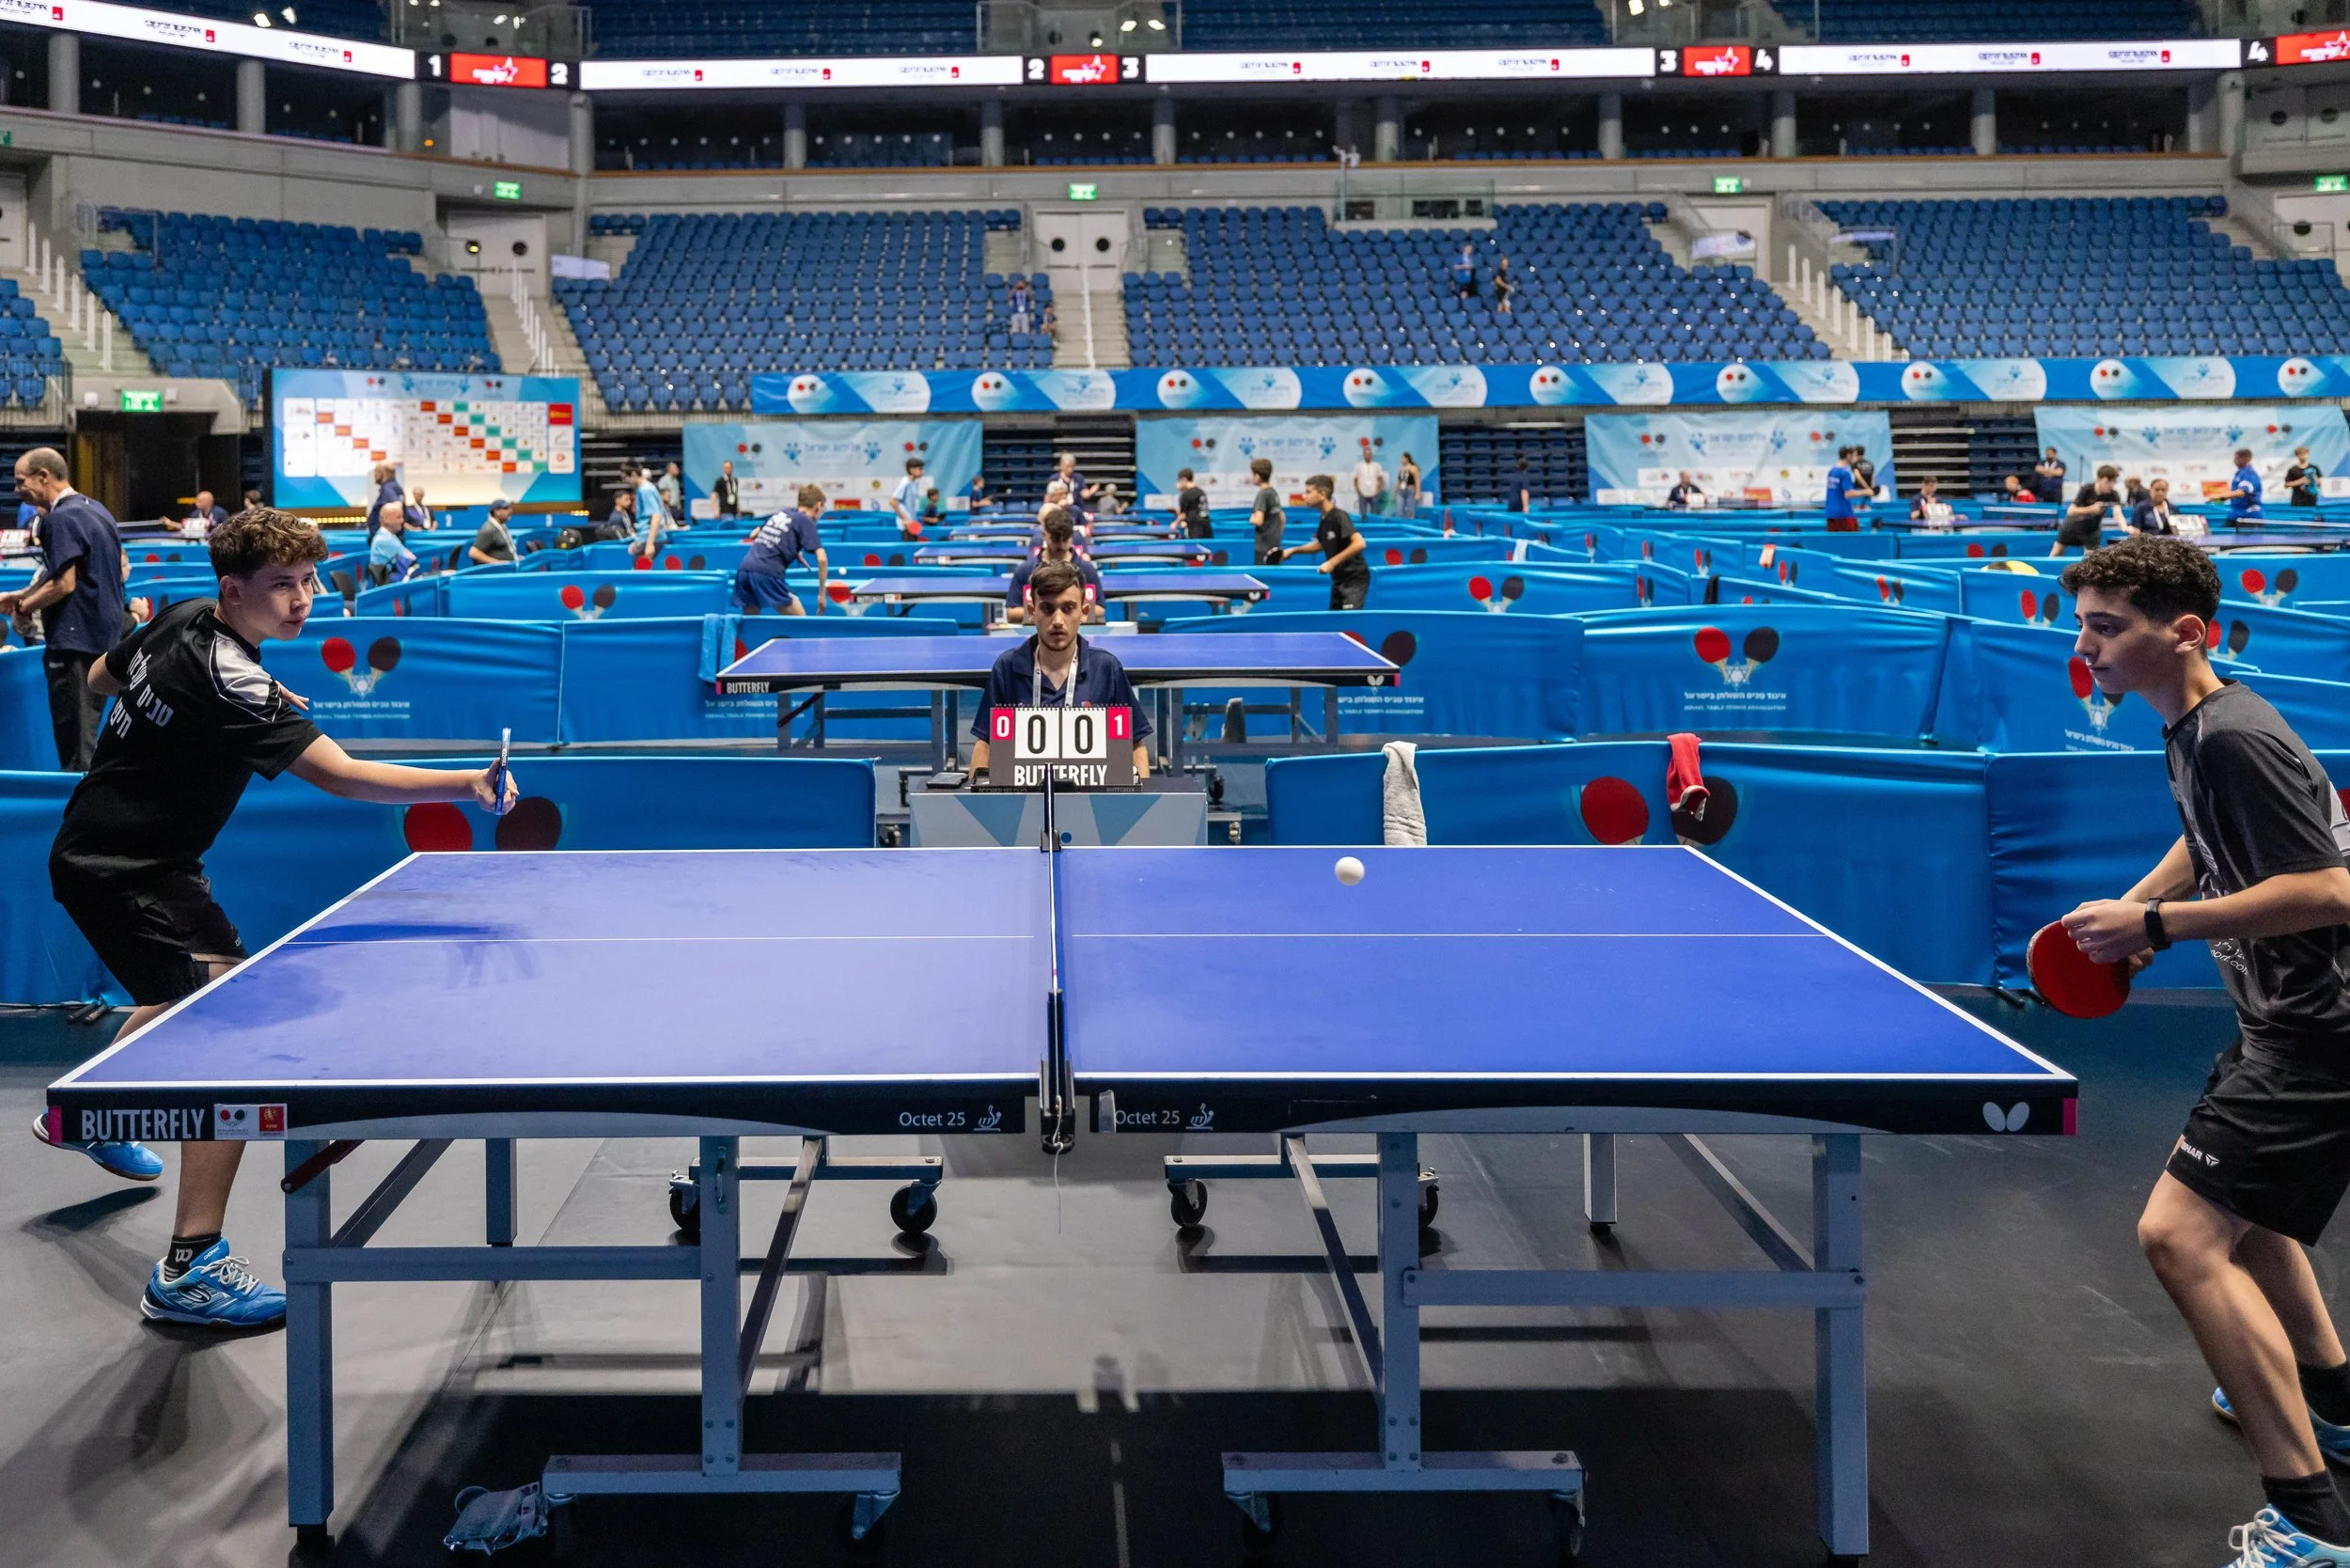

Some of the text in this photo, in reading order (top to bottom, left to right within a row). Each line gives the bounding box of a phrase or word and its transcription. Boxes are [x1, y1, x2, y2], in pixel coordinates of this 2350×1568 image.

[428, 55, 441, 77] 1
[1028, 58, 1044, 80] 2
[1121, 56, 1139, 79] 3
[1660, 50, 1677, 71] 3
[1755, 48, 1773, 71] 4
[551, 63, 568, 85] 2
[727, 682, 770, 694] BUTTERFLY
[996, 715, 1010, 737] 0
[1027, 714, 1093, 754] 0 0
[1114, 714, 1123, 736] 1
[81, 1108, 205, 1140] BUTTERFLY
[899, 1111, 943, 1126] Octet
[947, 1111, 965, 1126] 25
[1115, 1109, 1157, 1124] Octet
[1161, 1109, 1180, 1124] 25
